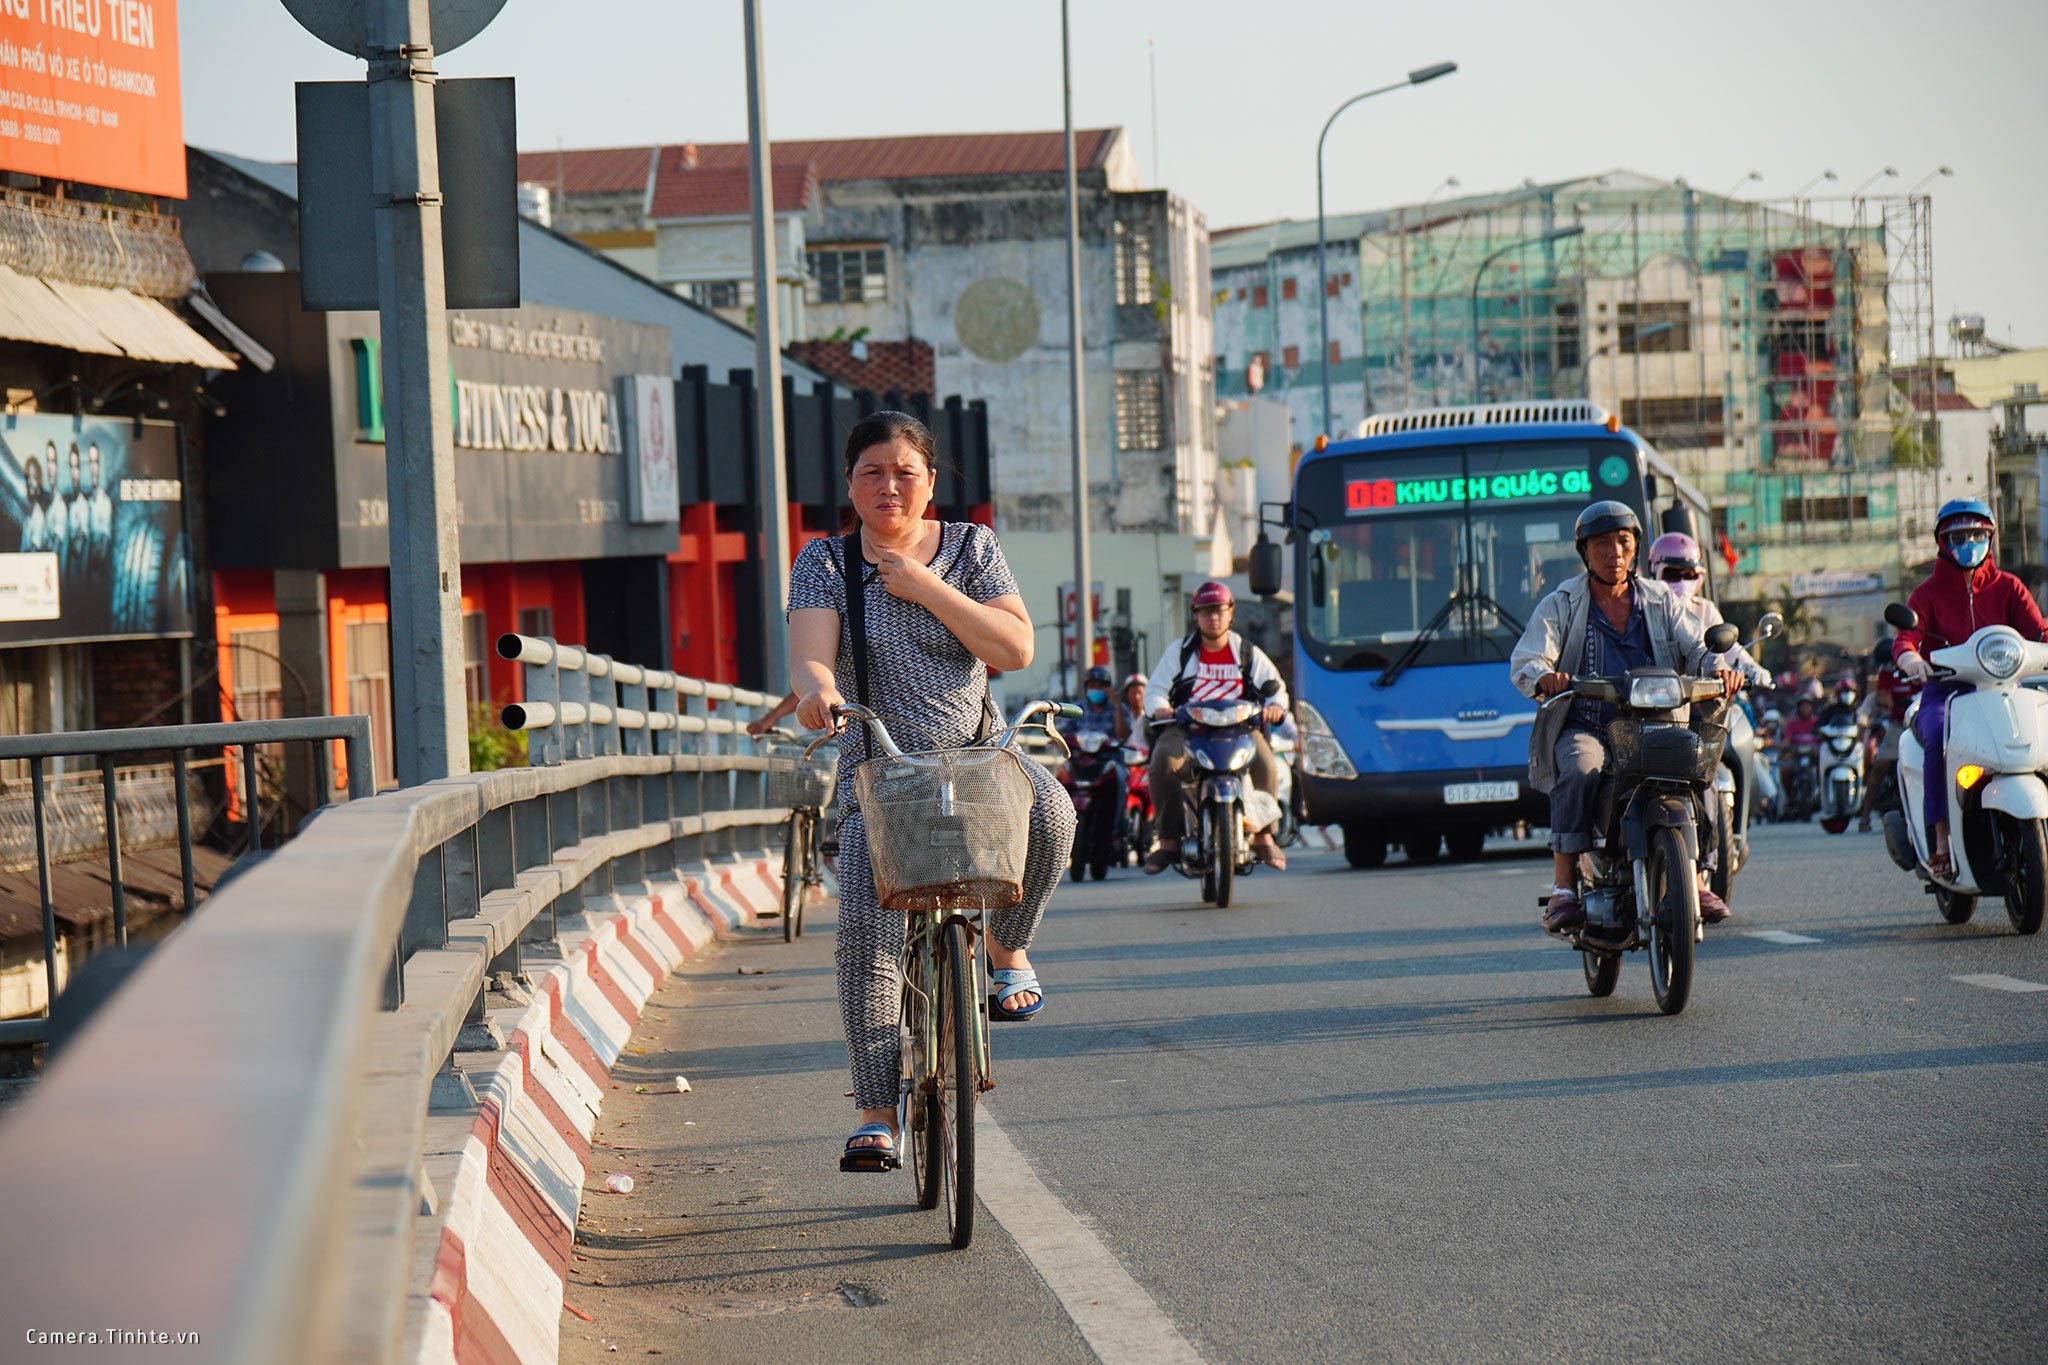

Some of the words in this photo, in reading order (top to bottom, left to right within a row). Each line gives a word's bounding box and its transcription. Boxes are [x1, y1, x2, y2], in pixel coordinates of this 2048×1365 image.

[66, 57, 81, 82] XE
[108, 66, 157, 97] HANKOOK
[456, 379, 550, 451] FITNESS
[551, 386, 569, 453] &
[568, 389, 622, 455] YOGA
[1347, 480, 1396, 510] 08
[1396, 480, 1448, 504] KHU
[1491, 469, 1558, 499] QUỐC
[1457, 709, 1499, 721] SAMCO
